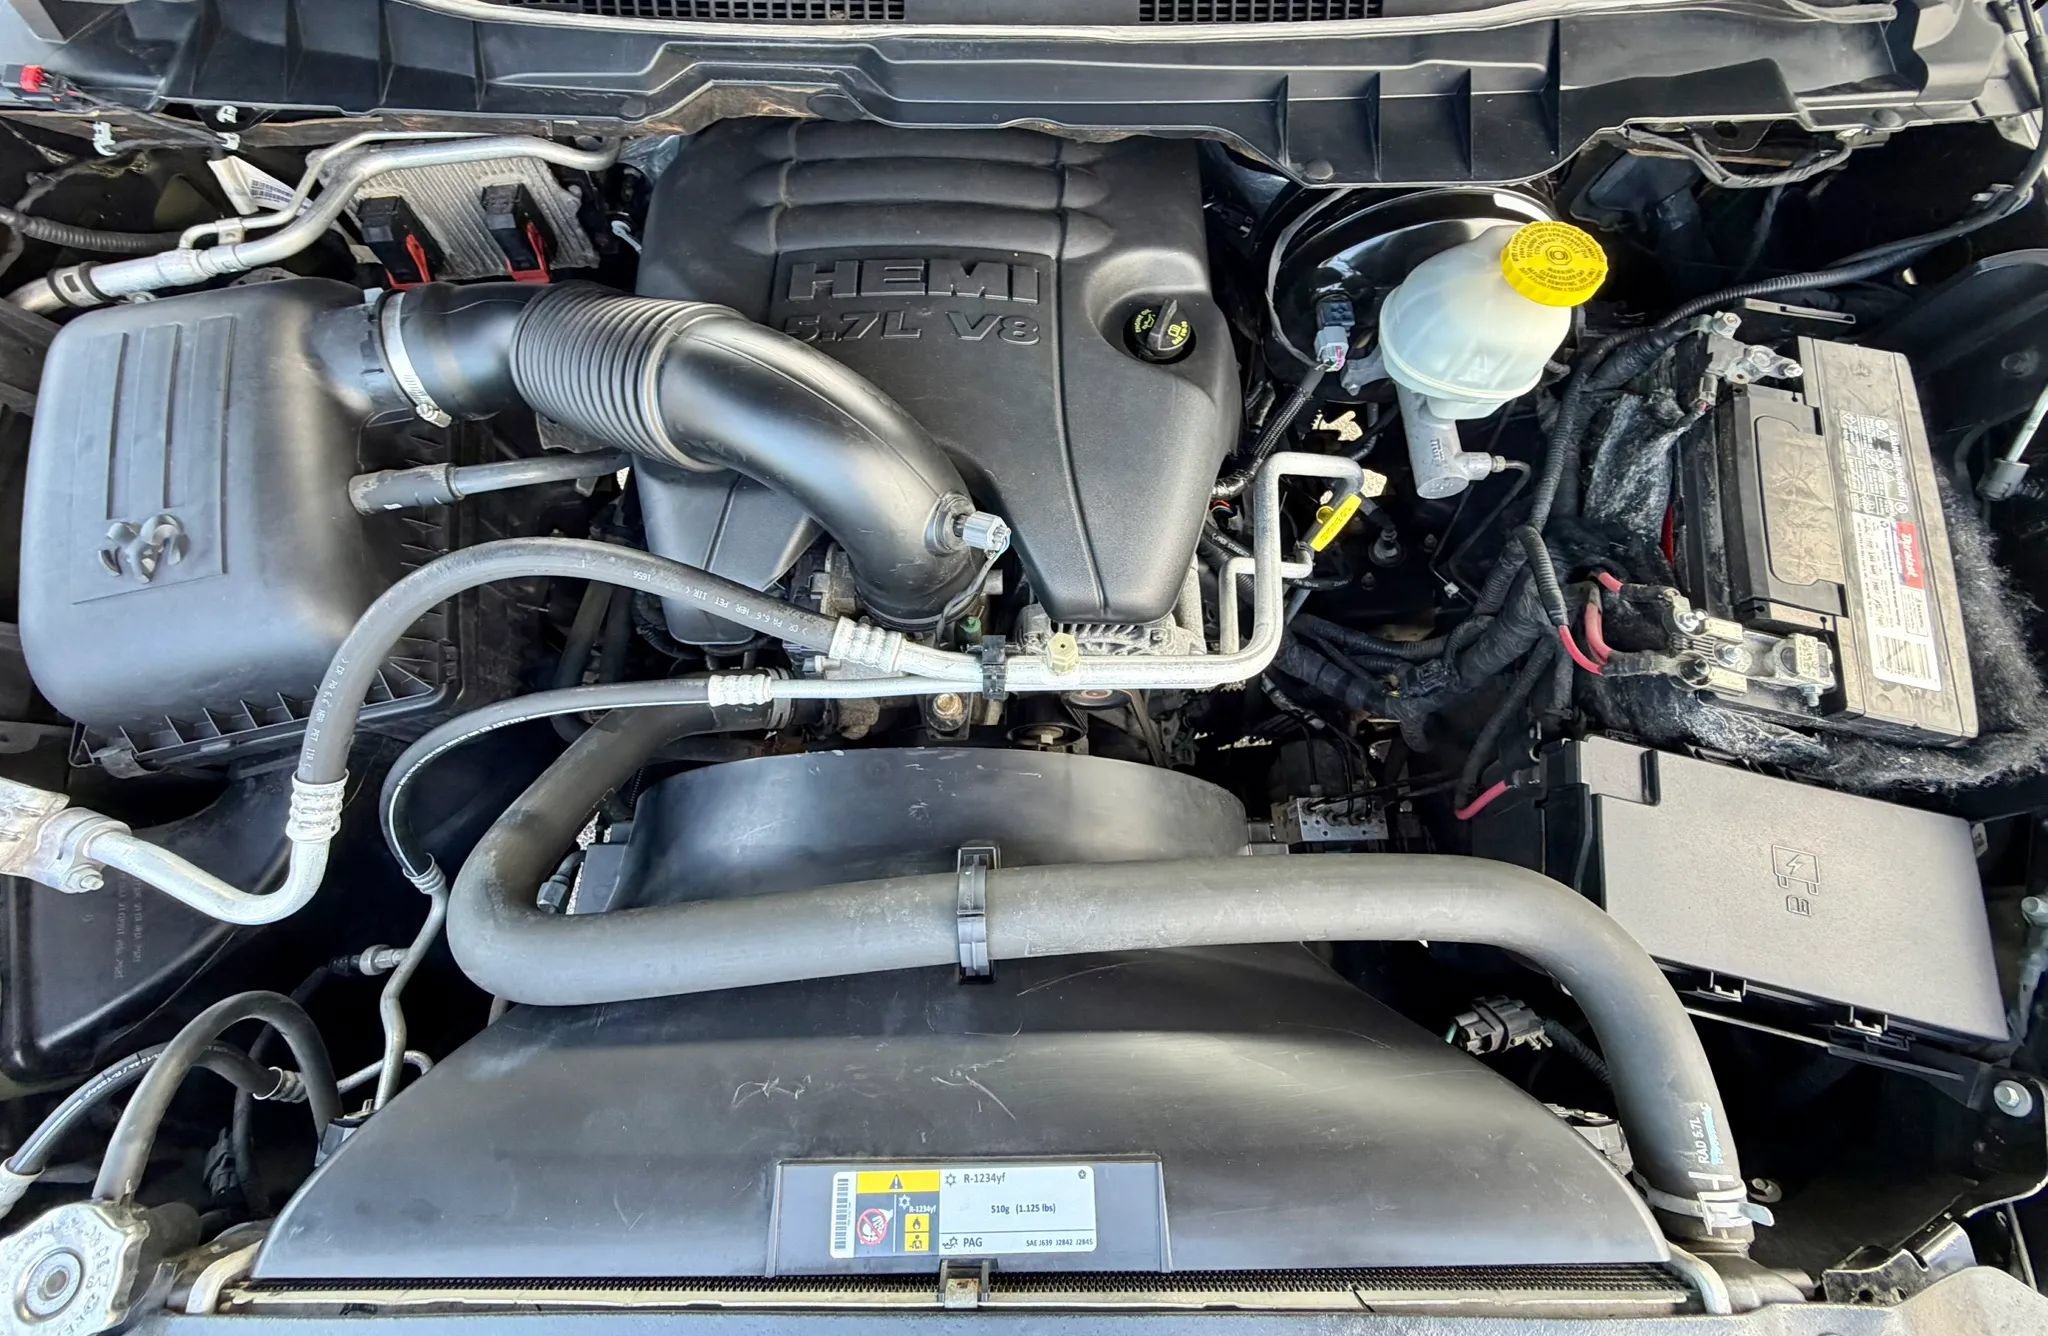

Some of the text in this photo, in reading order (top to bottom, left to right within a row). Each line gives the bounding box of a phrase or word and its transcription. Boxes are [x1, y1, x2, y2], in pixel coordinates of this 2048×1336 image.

[787, 259, 1040, 304] HEMI
[783, 310, 1041, 346] 5.7L V8
[714, 597, 729, 609] PET
[1693, 1139, 1710, 1165] RAD
[963, 1172, 1006, 1184] R-1234yf
[908, 1204, 937, 1215] R-1234yf
[991, 1203, 1056, 1215] 510g (1.125 lbs)
[963, 1237, 983, 1248] PAG
[1026, 1239, 1037, 1247] SAE
[1039, 1239, 1053, 1247] J639
[1055, 1238, 1073, 1246] J2842
